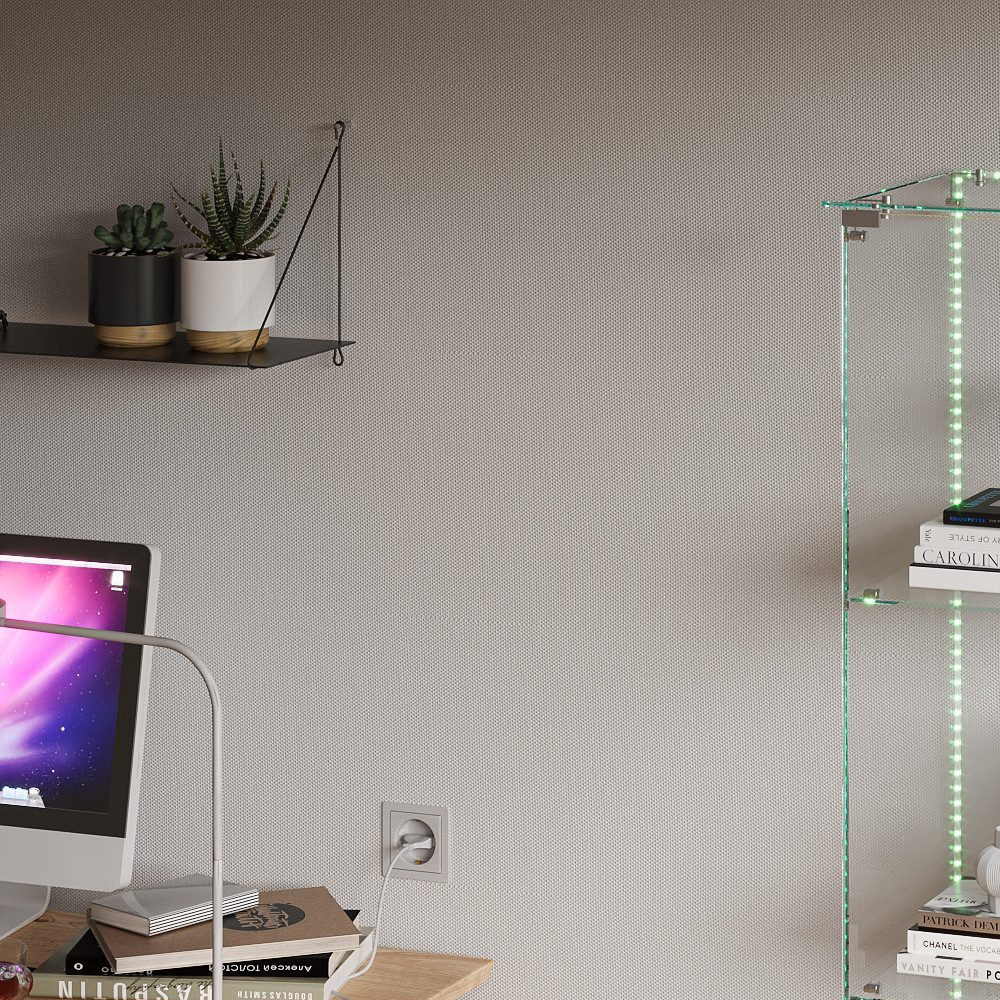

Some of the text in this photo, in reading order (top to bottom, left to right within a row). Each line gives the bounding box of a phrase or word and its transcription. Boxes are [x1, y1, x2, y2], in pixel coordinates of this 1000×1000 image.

[924, 529, 932, 543] Yale
[949, 533, 975, 542] STYLE
[977, 536, 990, 544] OF
[923, 915, 970, 928] PATRICK
[923, 940, 958, 951] CHANEL
[960, 944, 974, 952] THE
[263, 964, 313, 973] Алексей
[901, 962, 945, 975] VANITY
[951, 967, 980, 979] FAIR
[237, 990, 313, 1000] DOUGLAS SMITH
